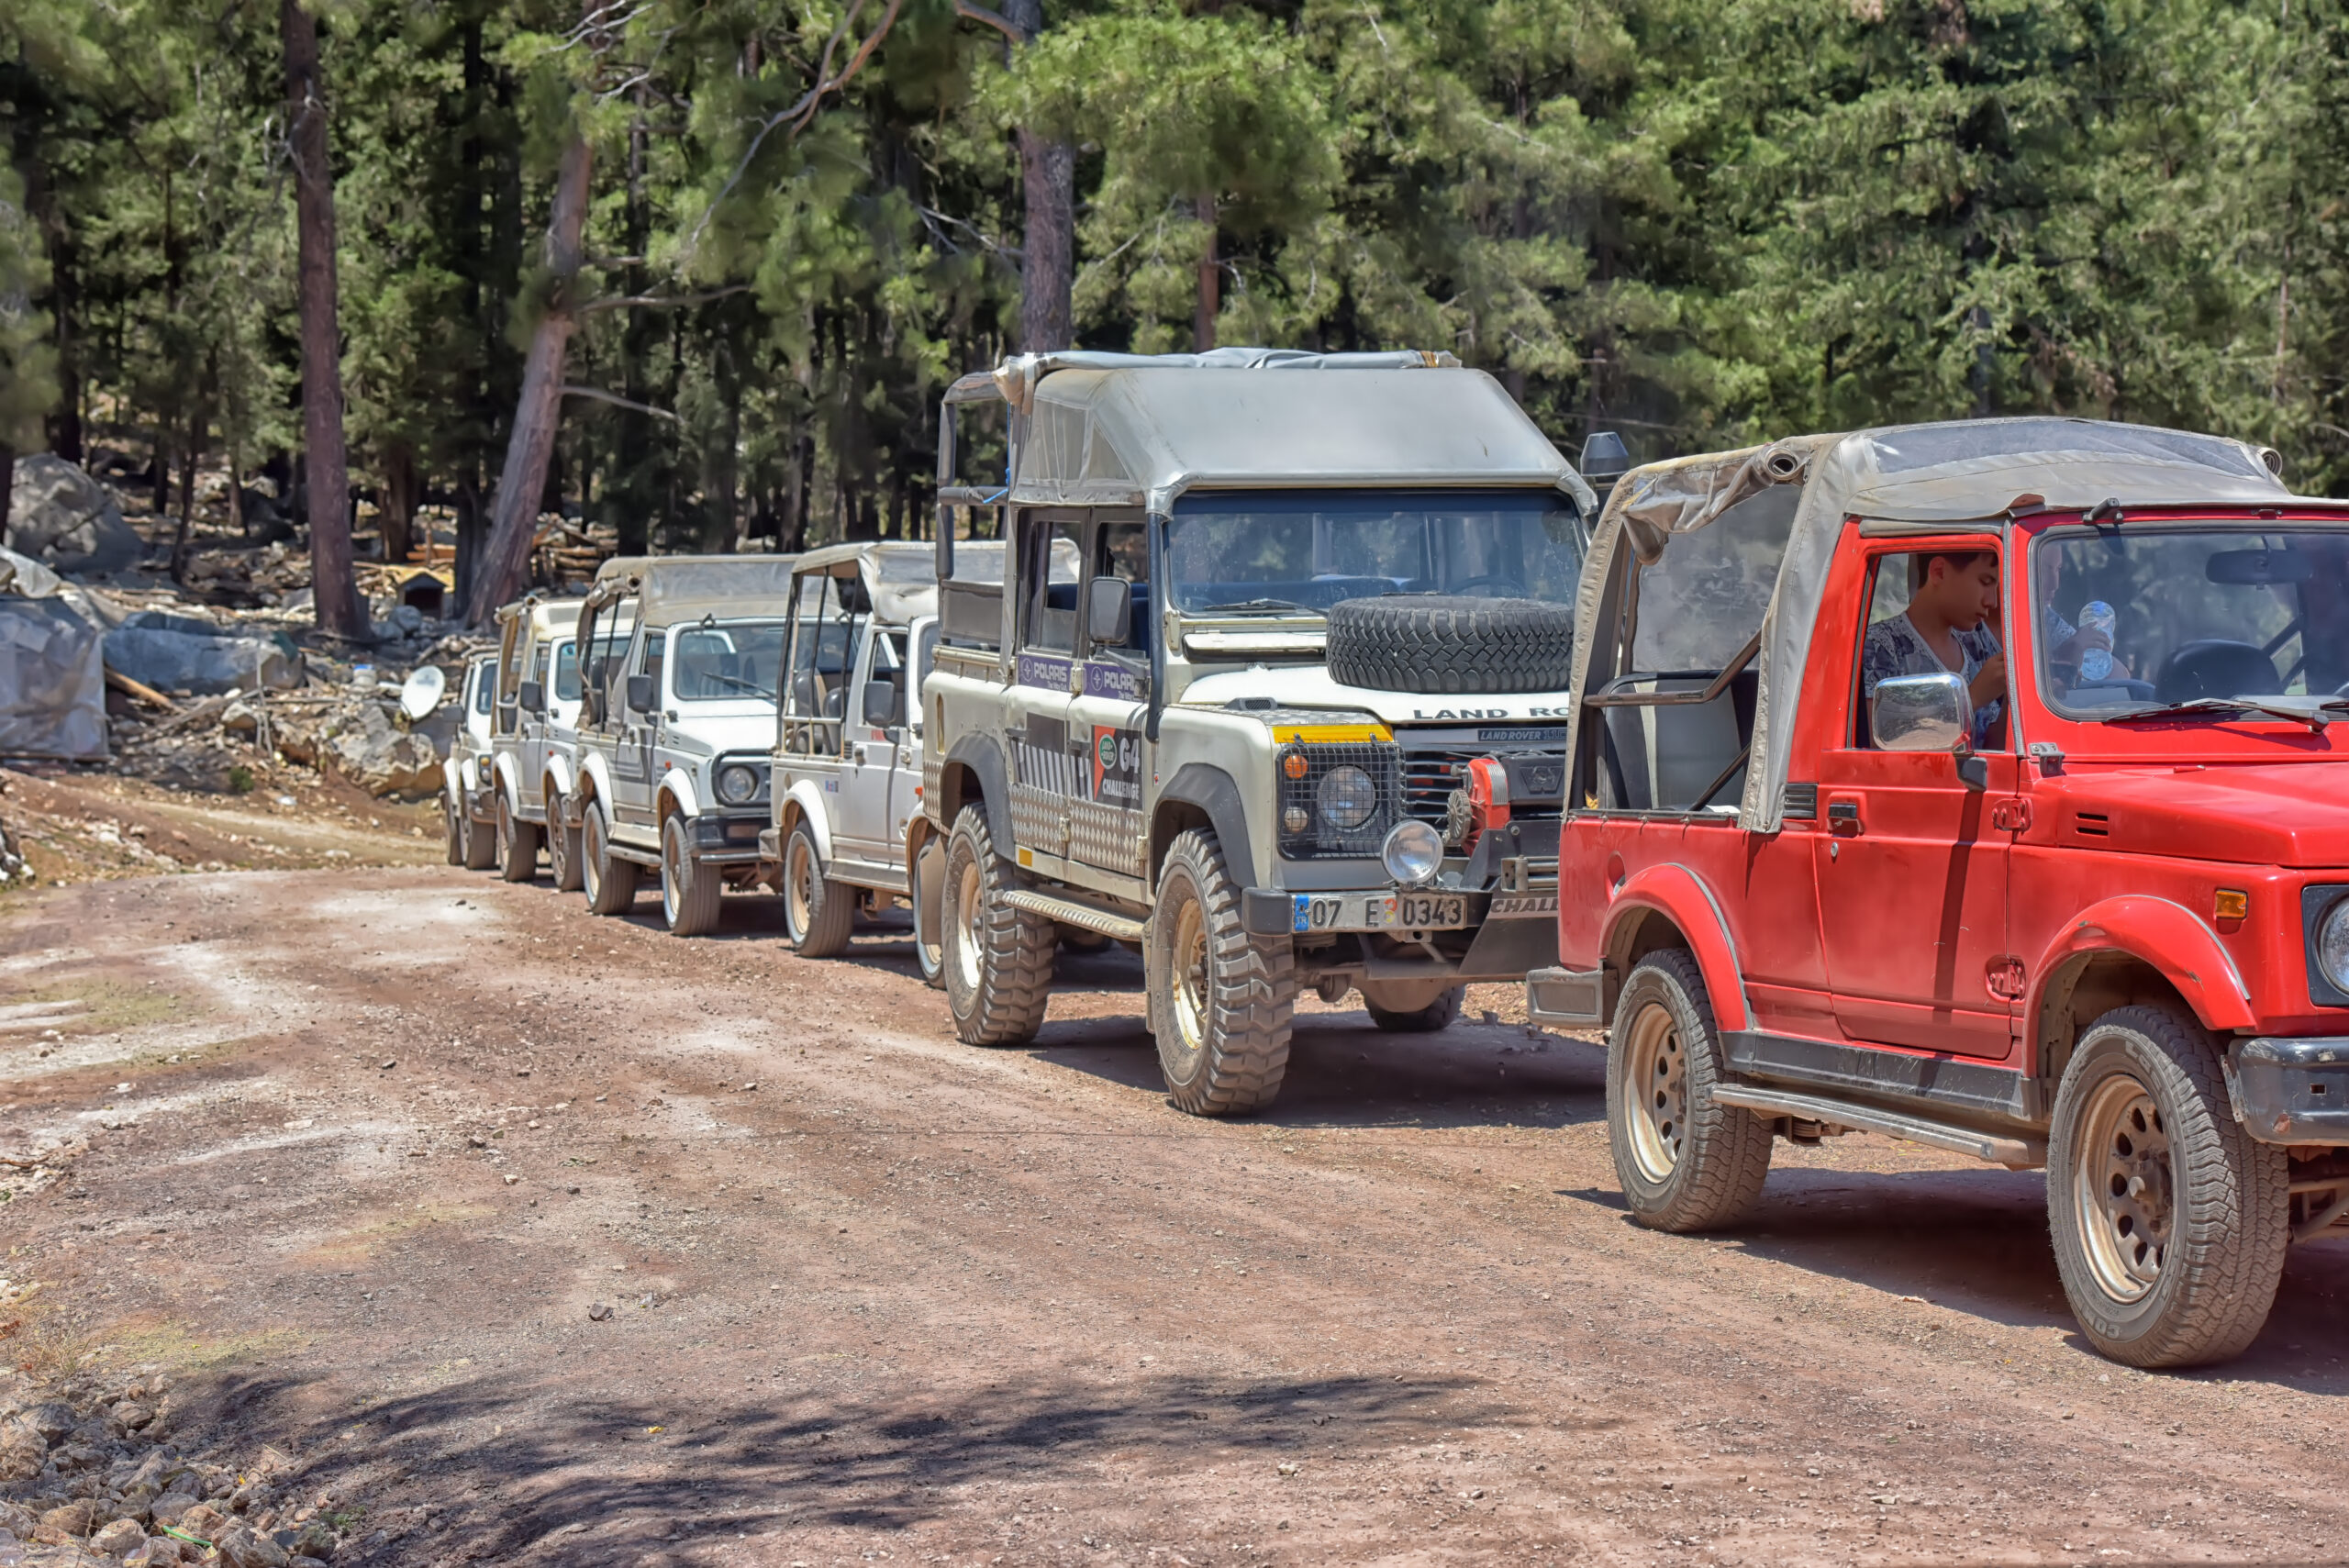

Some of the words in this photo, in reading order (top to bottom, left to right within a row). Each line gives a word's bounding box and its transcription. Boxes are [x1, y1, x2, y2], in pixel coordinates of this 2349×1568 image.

[1033, 662, 1068, 682] POLARIS
[1104, 671, 1135, 691] POLARI
[1413, 708, 1508, 719] LAND
[1480, 730, 1507, 740] LAND
[1508, 730, 1542, 740] ROVER
[1119, 737, 1140, 773] G4
[1102, 777, 1140, 800] CHALLENGE
[1296, 917, 1308, 926] TR
[1312, 898, 1342, 928] 07
[1365, 899, 1380, 928] E
[1403, 898, 1463, 927] 0343
